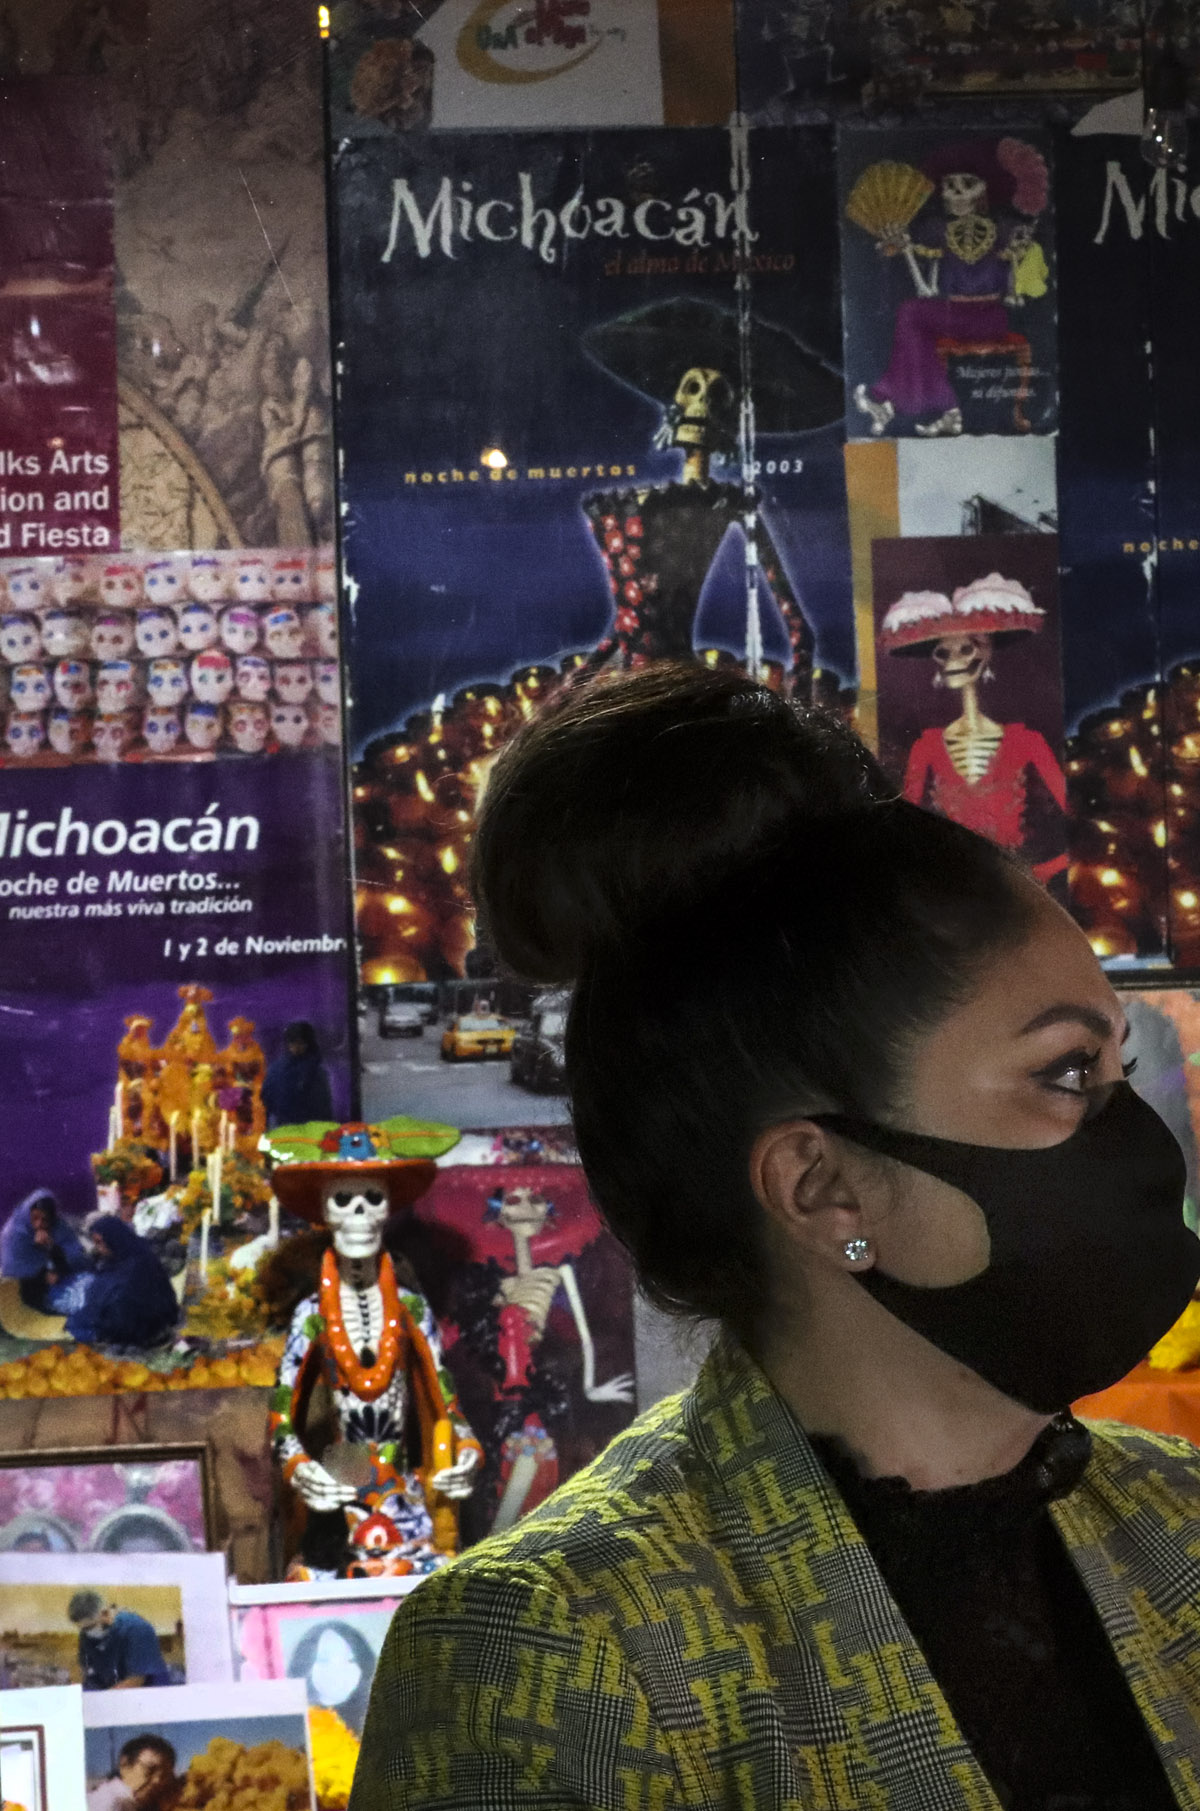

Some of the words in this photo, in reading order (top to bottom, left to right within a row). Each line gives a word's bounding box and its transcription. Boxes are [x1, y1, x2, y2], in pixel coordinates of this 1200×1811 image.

[380, 172, 759, 264] Michoacán
[49, 449, 110, 475] Arts
[404, 467, 479, 484] noche
[490, 465, 517, 481] de
[528, 464, 636, 479] muertos
[752, 460, 803, 475] 2003
[0, 486, 44, 512] ion
[54, 485, 110, 511] and
[21, 522, 111, 548] Fiesta
[1122, 536, 1199, 553] noche
[66, 870, 99, 894] de
[106, 869, 241, 893] Muertos...
[8, 901, 80, 920] nuestra
[84, 898, 122, 918] más
[127, 897, 165, 916] viva
[169, 895, 253, 915] tradición
[178, 942, 192, 962] y
[196, 937, 208, 956] 2
[214, 937, 239, 956] de
